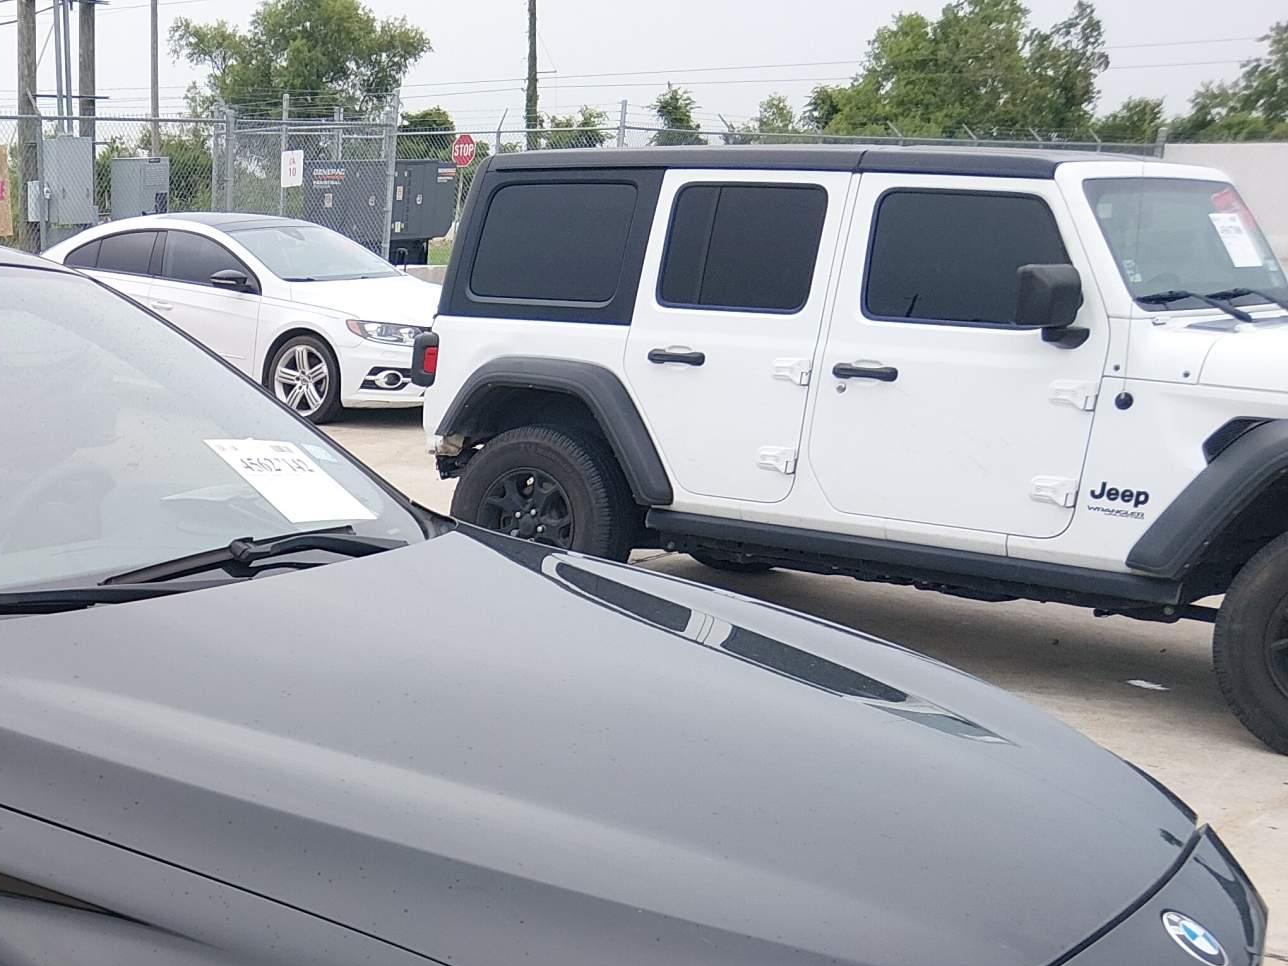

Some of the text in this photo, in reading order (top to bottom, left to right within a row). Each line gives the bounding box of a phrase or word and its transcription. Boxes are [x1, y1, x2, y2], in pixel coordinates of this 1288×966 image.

[454, 143, 474, 157] STOP
[288, 167, 297, 177] 10
[1089, 481, 1150, 508] Jeep
